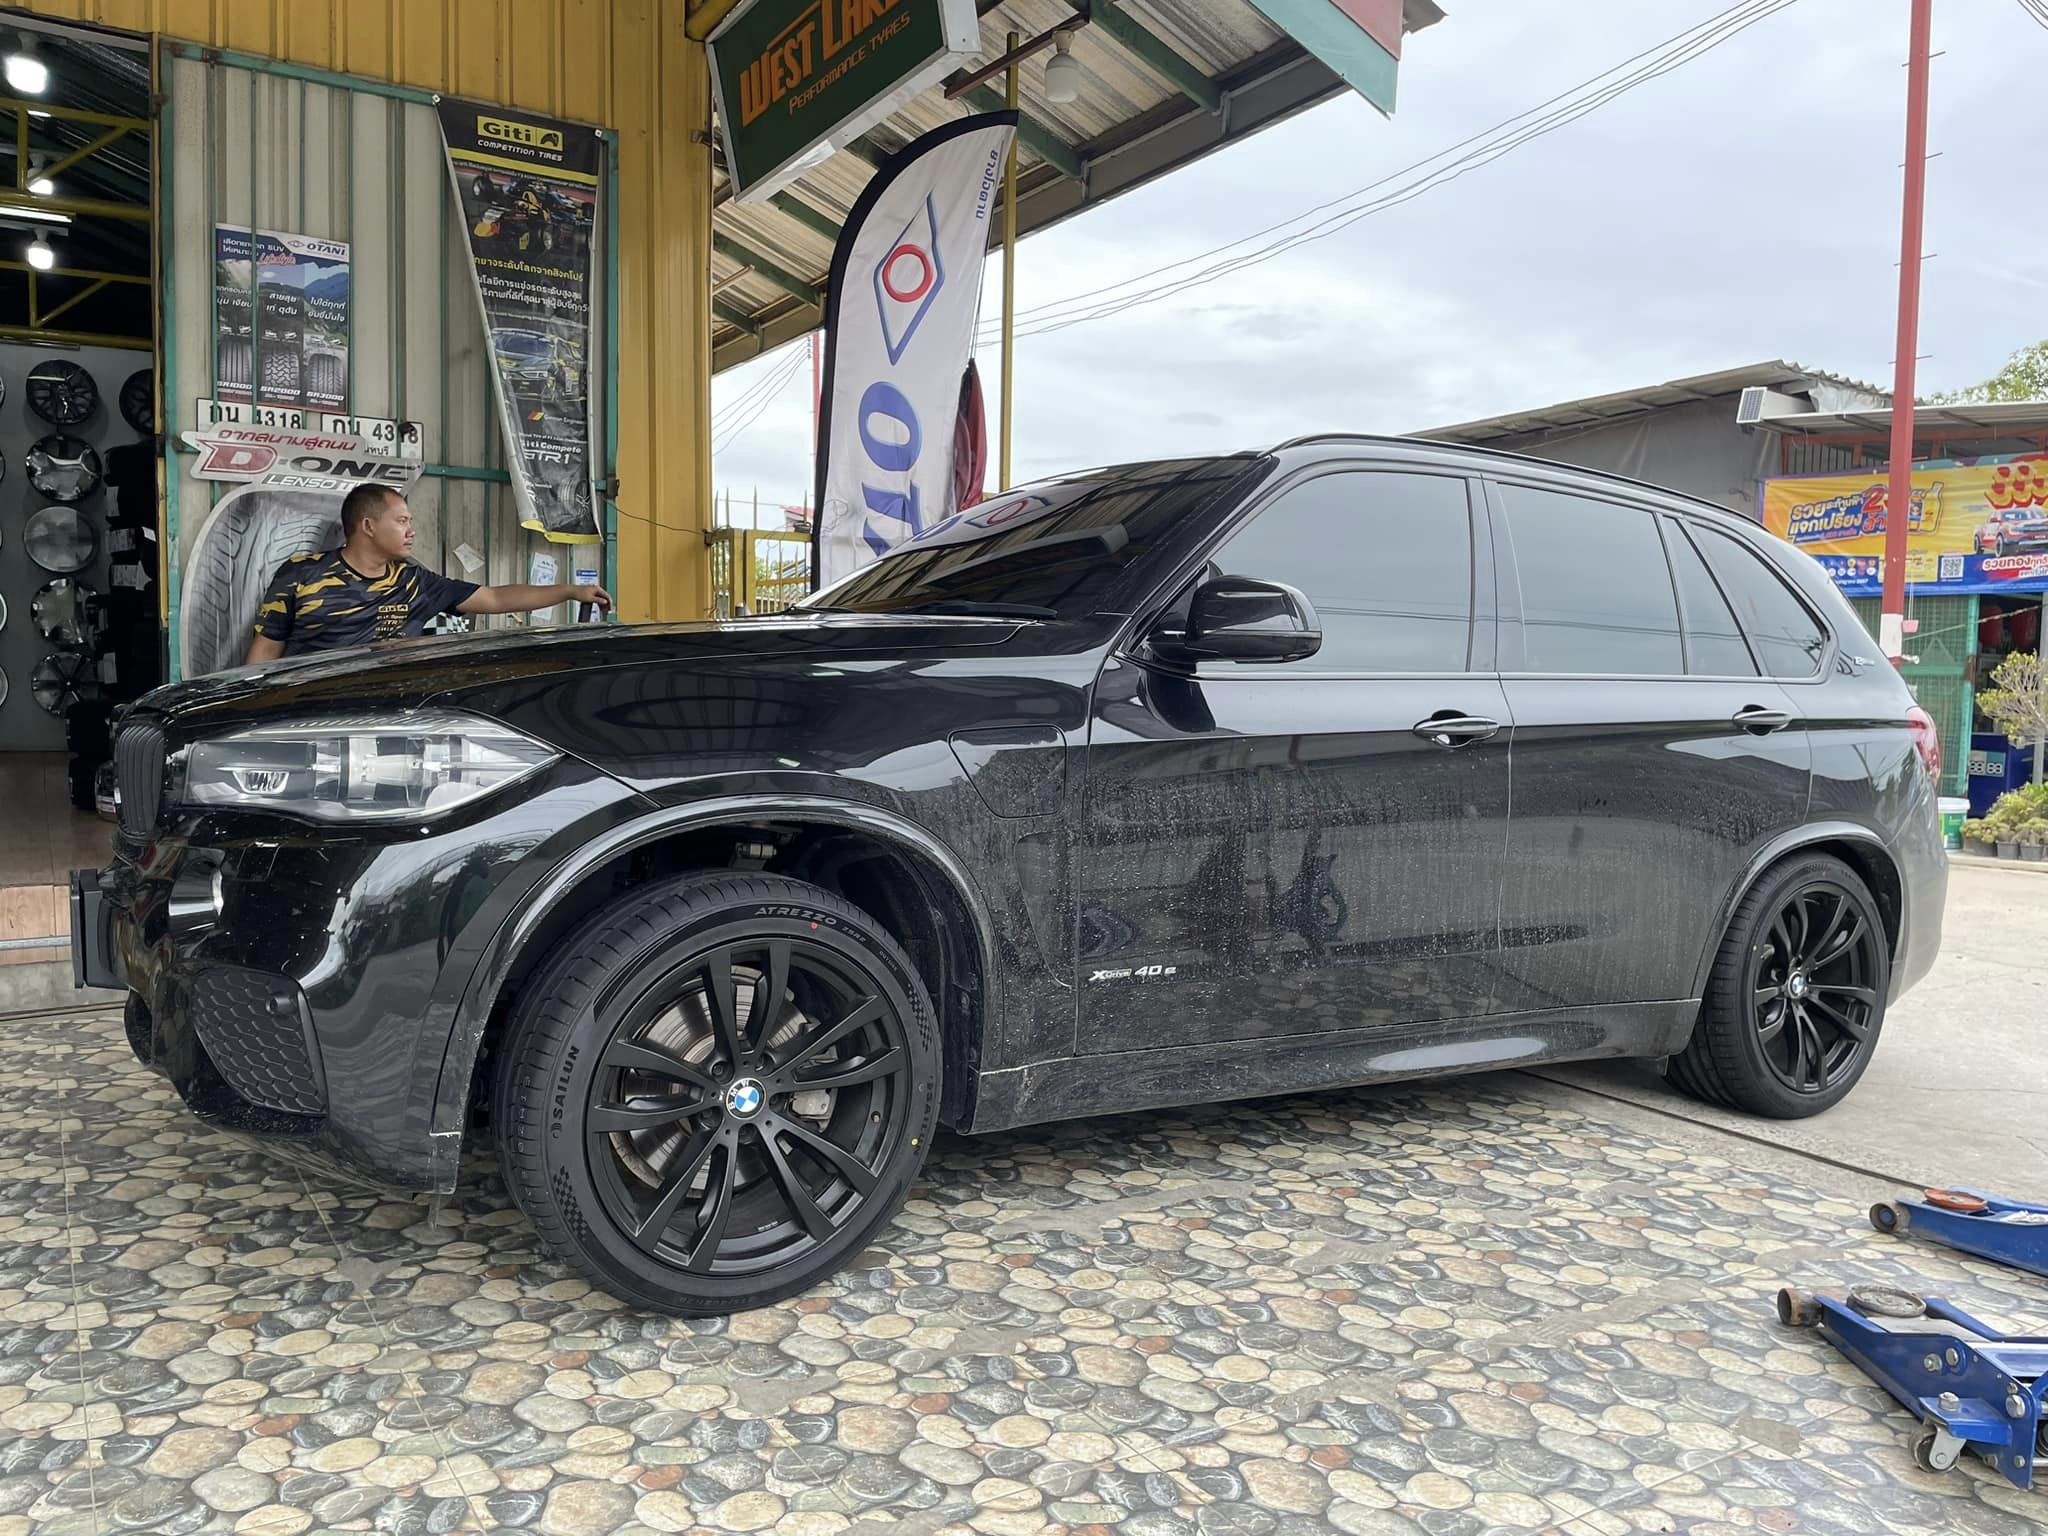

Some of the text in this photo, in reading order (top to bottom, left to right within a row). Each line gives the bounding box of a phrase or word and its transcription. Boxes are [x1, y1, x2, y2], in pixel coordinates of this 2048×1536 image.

[739, 0, 900, 127] WEST LAK
[788, 10, 911, 116] PERFORMANCE TYRES
[483, 121, 531, 142] Giti
[477, 139, 563, 162] COMPETITION TIRES
[307, 243, 346, 256] OTANI
[267, 474, 337, 489] LENSO
[754, 906, 838, 926] ATREZZO
[553, 1045, 580, 1120] SAILUN
